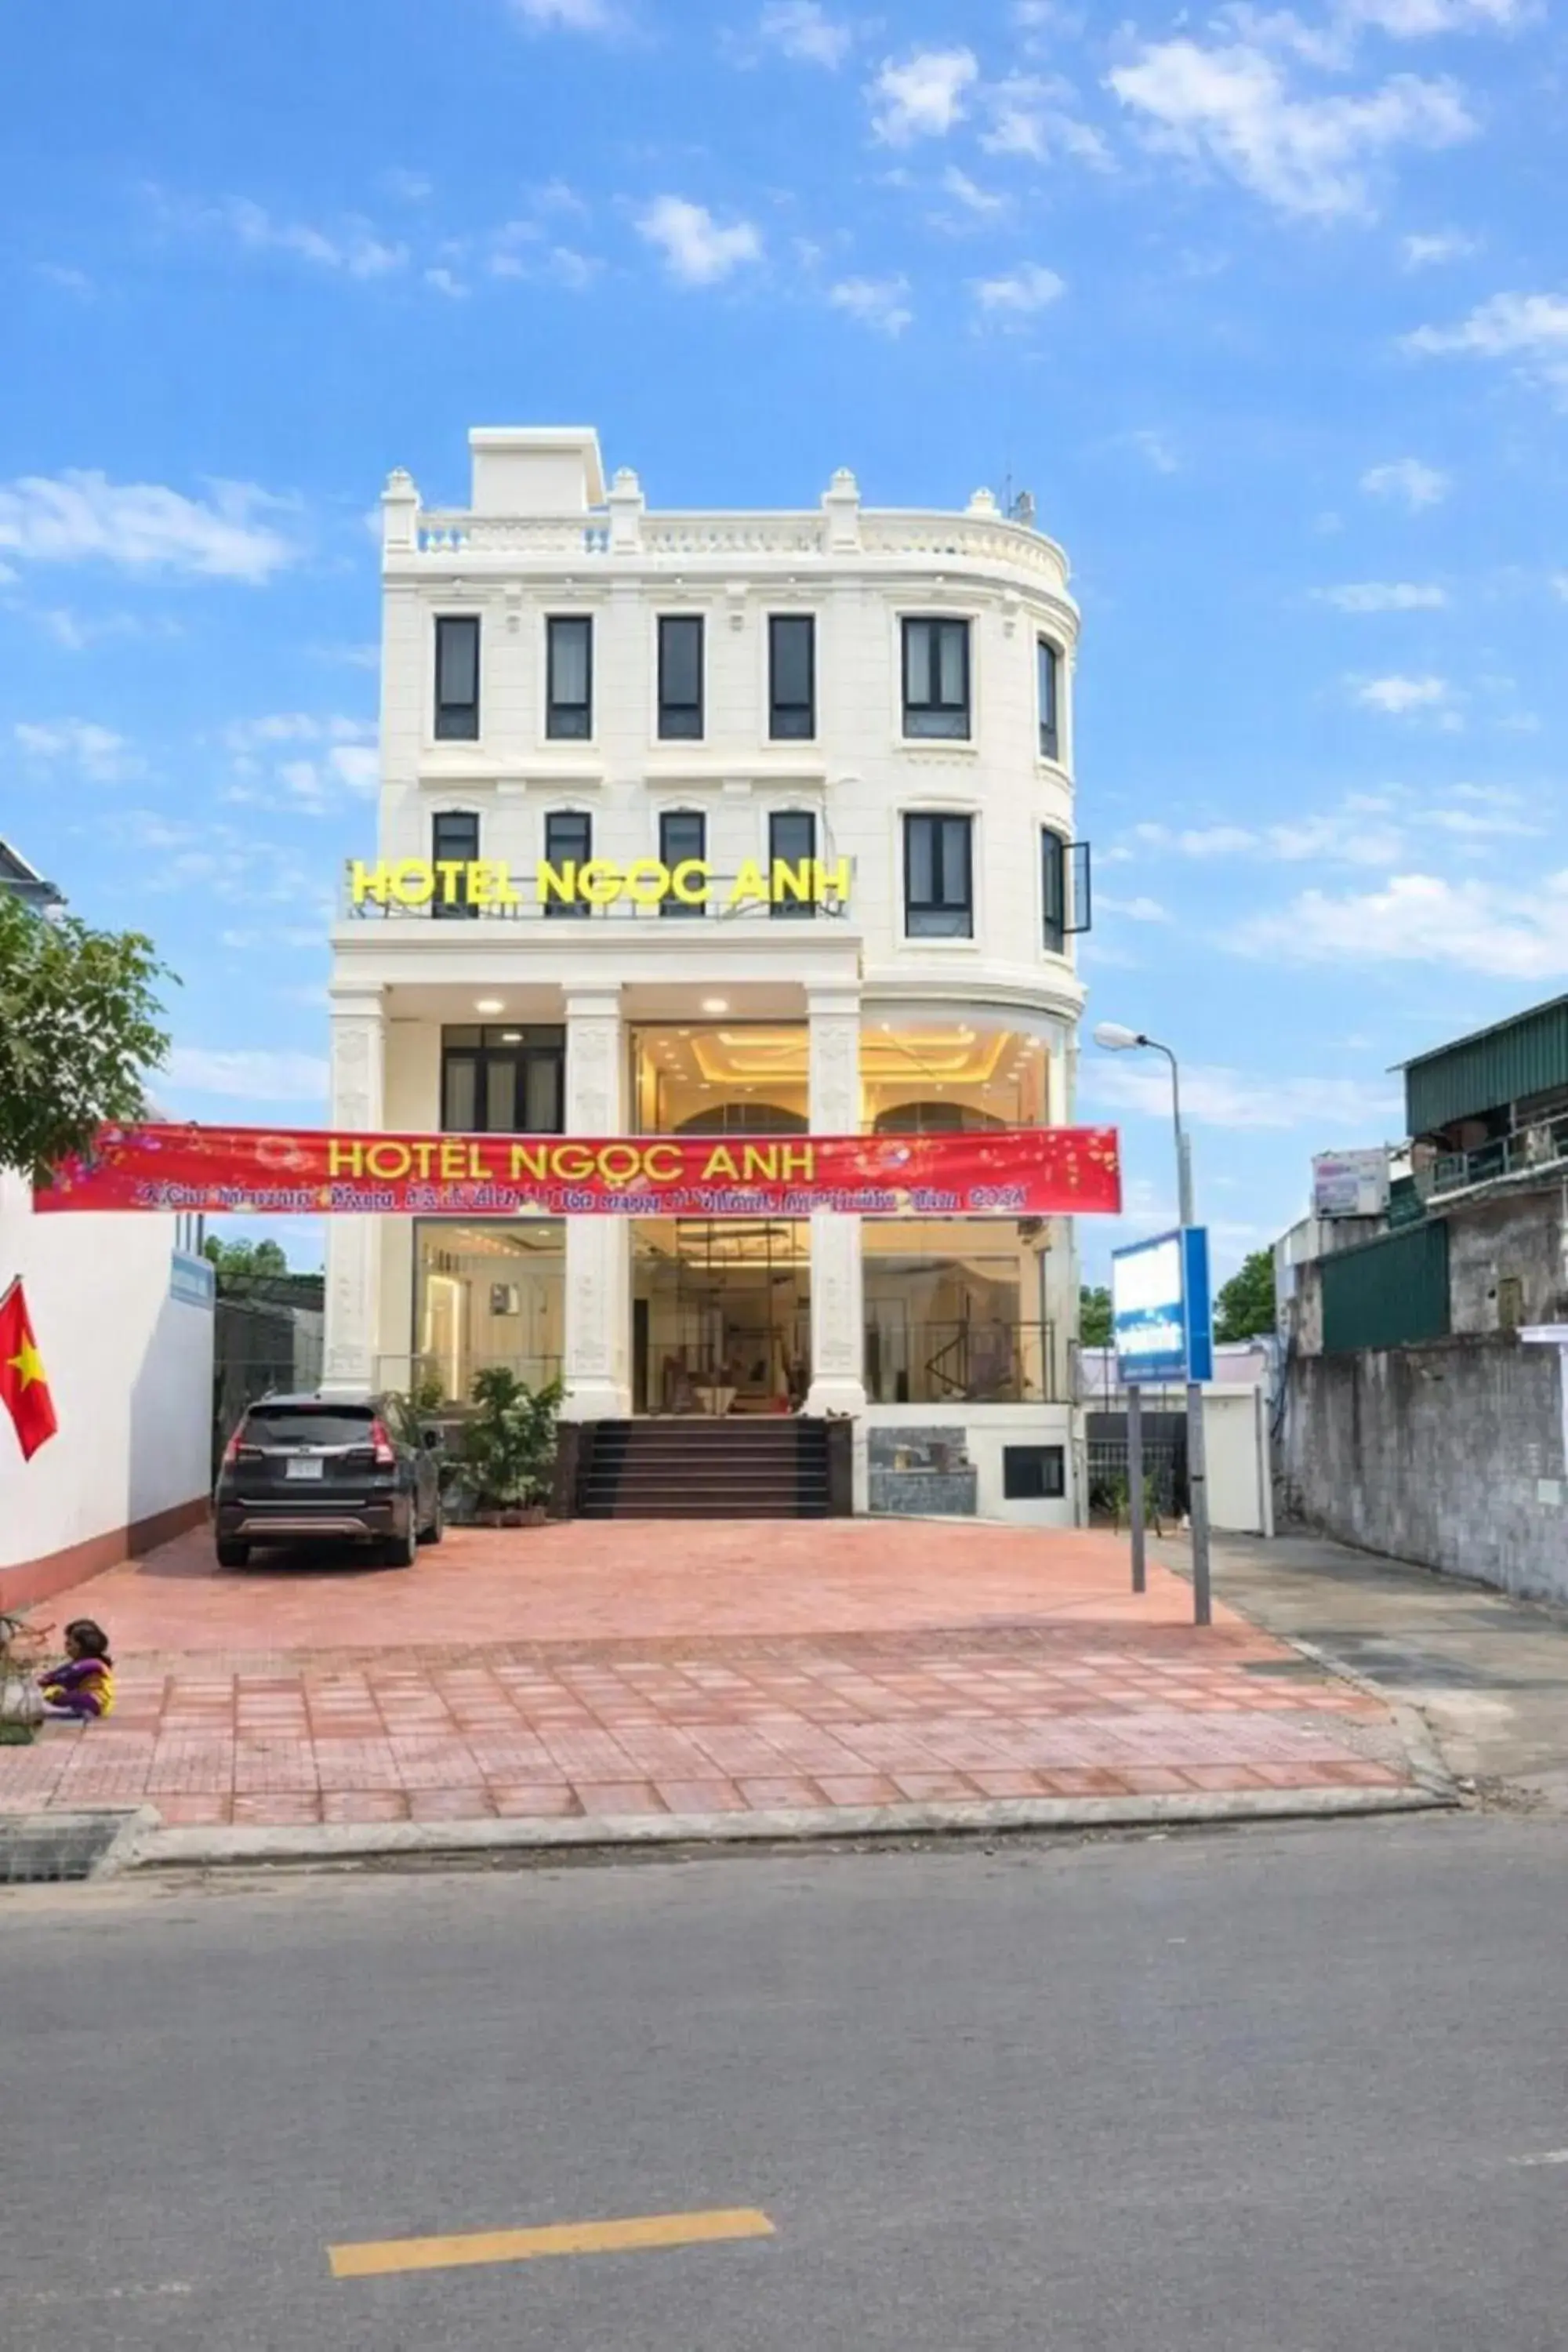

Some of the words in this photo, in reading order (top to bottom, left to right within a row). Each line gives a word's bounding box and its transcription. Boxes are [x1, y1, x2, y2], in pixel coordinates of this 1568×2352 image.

[353, 858, 523, 906] HOTEL
[728, 856, 851, 906] ANH
[700, 1142, 814, 1181] ANH
